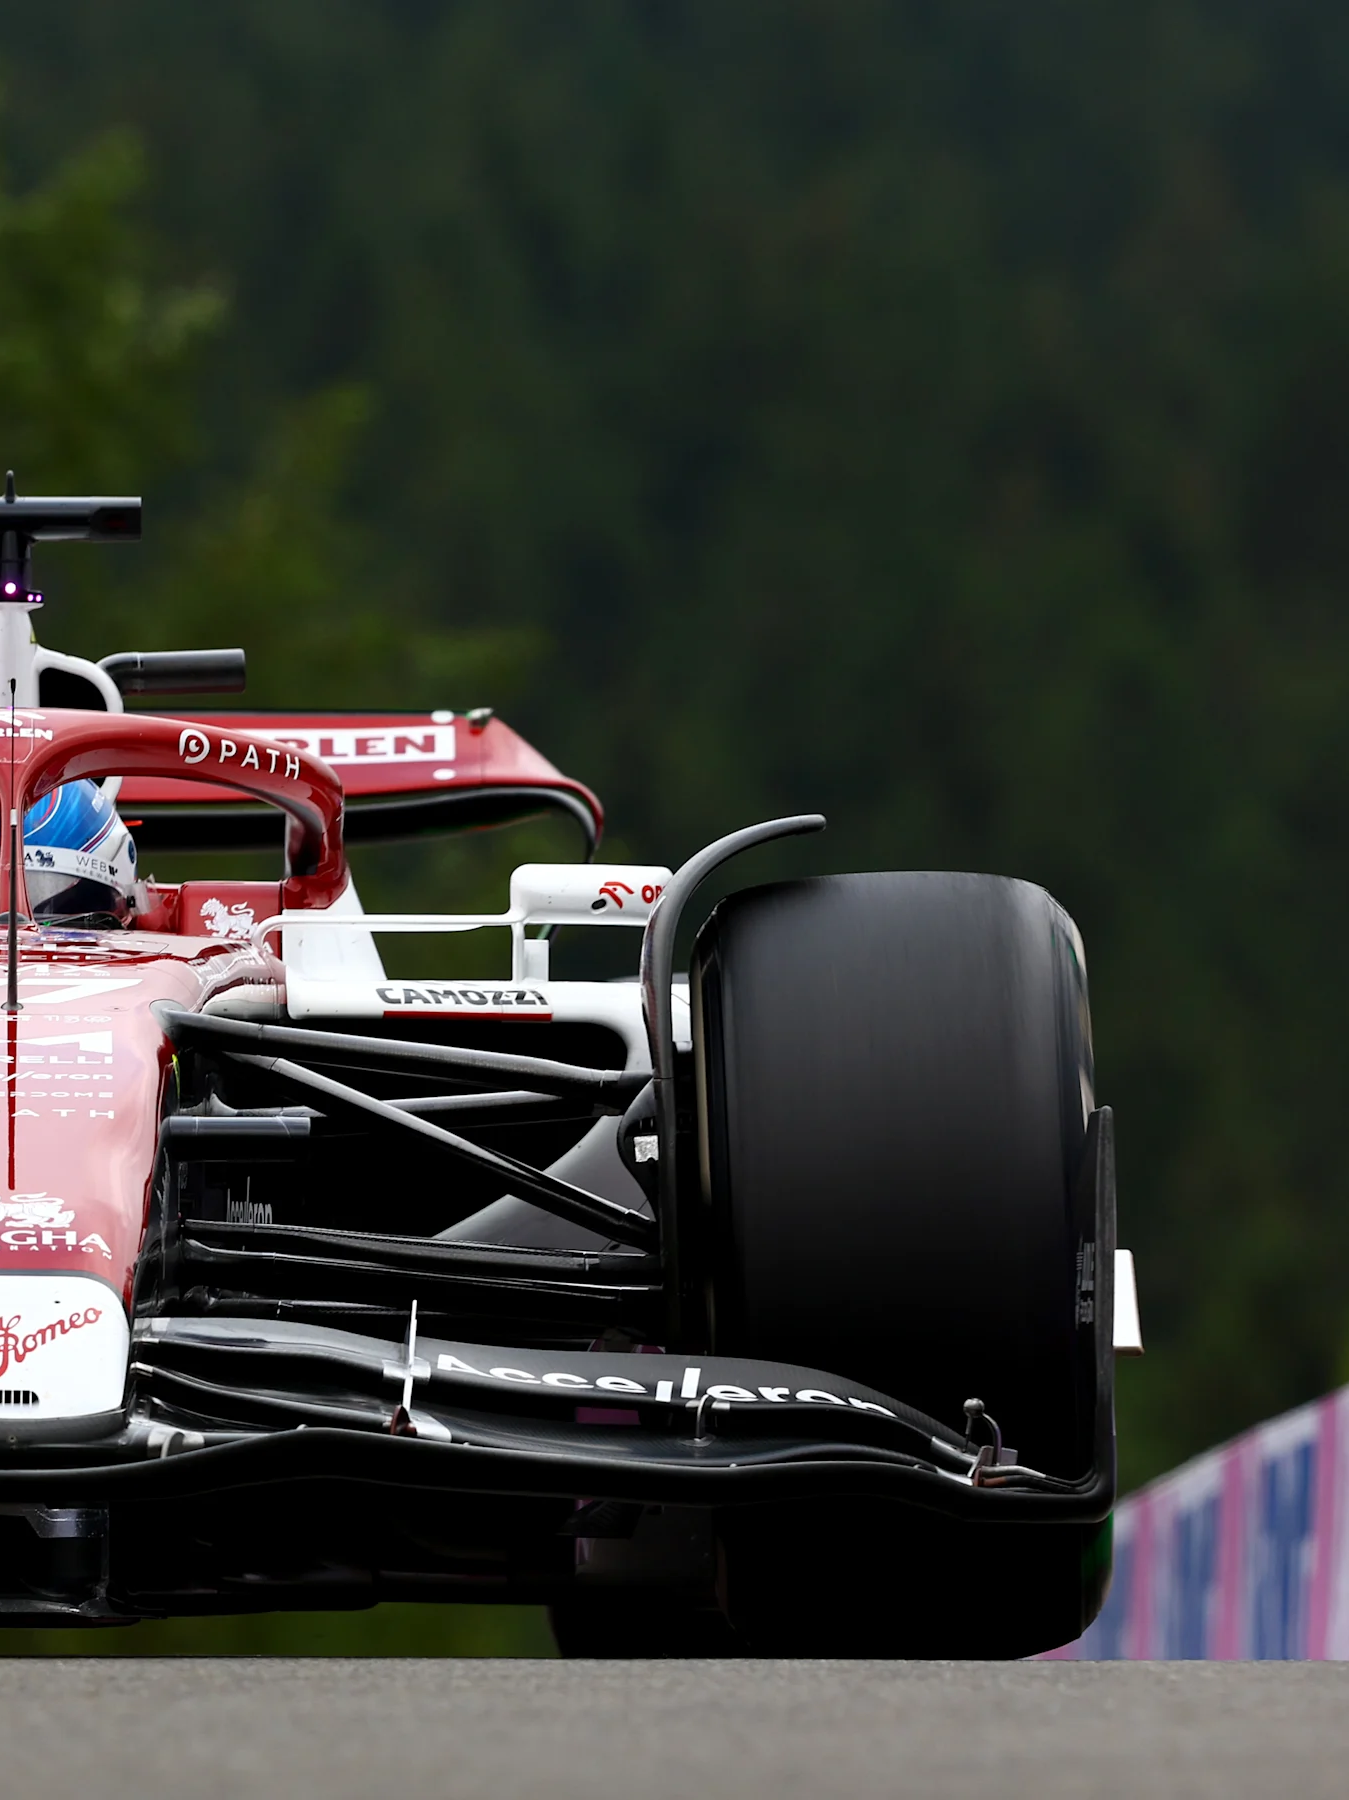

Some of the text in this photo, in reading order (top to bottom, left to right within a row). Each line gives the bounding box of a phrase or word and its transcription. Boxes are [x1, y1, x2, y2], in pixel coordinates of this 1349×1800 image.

[219, 739, 301, 780] PATH
[76, 855, 107, 873] WEB
[375, 987, 549, 1006] CAMOZZI
